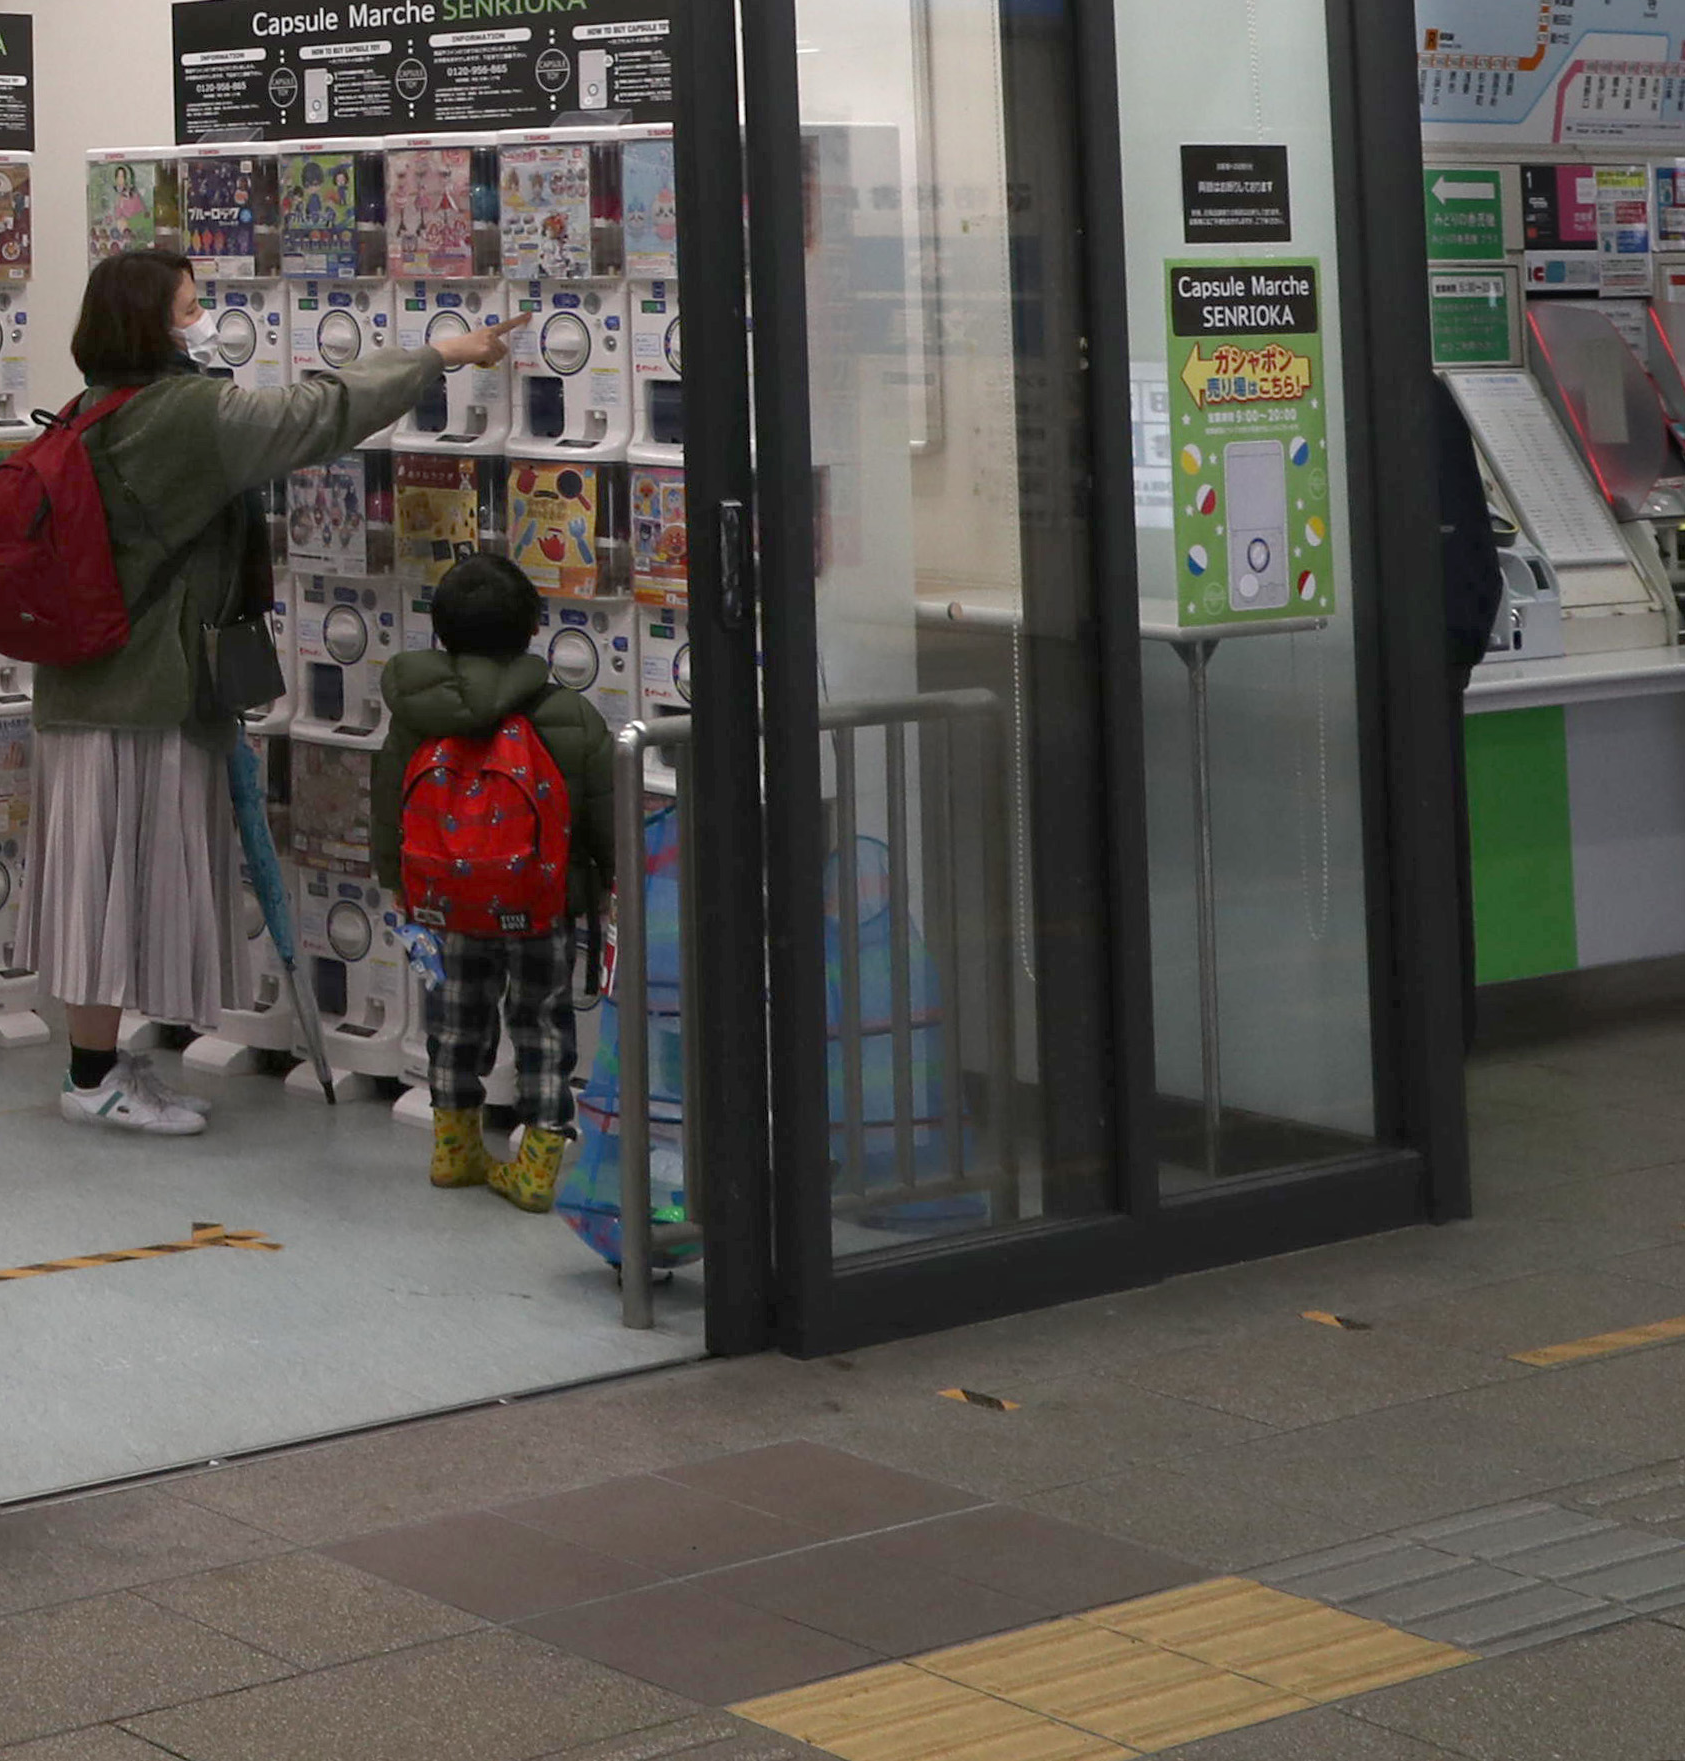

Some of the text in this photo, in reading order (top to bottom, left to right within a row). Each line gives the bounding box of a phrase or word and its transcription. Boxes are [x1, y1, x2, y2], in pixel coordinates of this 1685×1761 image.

[251, 7, 339, 37] Capsule
[348, 0, 435, 29] Marche
[1178, 274, 1310, 299] Capsule Marche
[1202, 304, 1295, 328] SENRIOKA
[1213, 345, 1294, 376] ガシャポン
